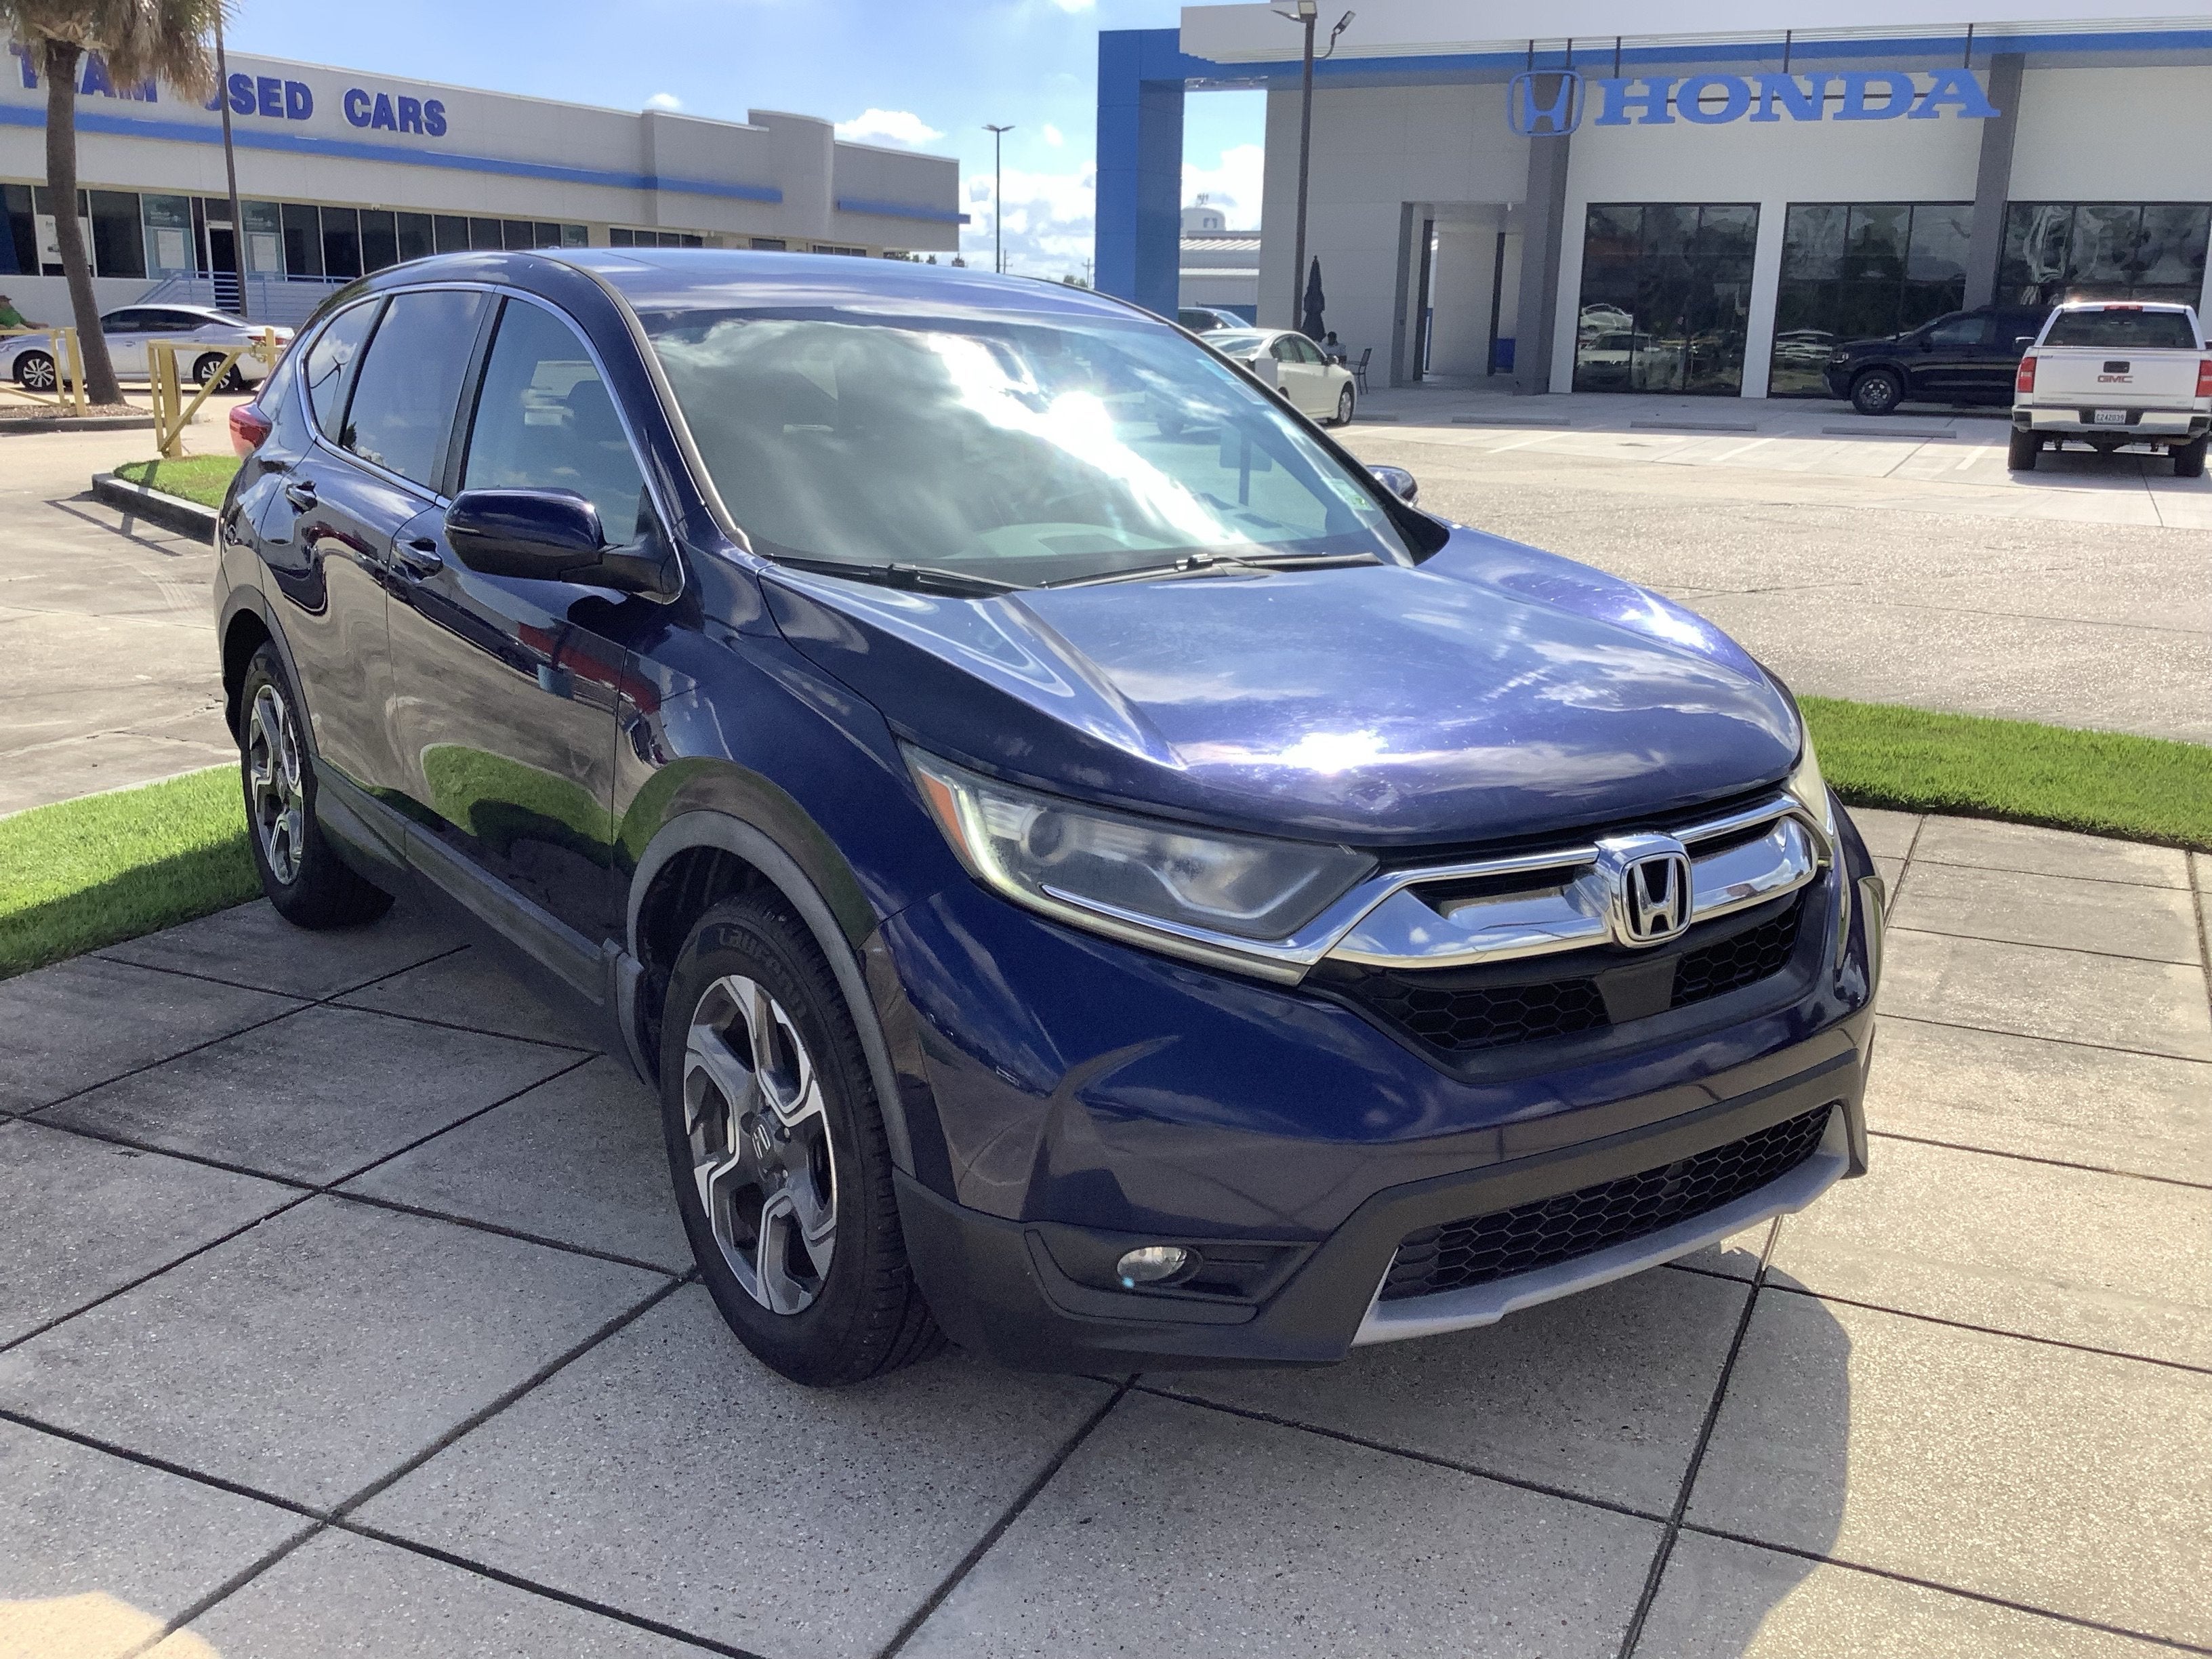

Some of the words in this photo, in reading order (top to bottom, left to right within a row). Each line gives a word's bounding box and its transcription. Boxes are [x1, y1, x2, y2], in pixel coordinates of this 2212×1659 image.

[344, 88, 447, 137] CARS
[1595, 68, 2001, 125] HONDA
[2097, 375, 2133, 384] GMC
